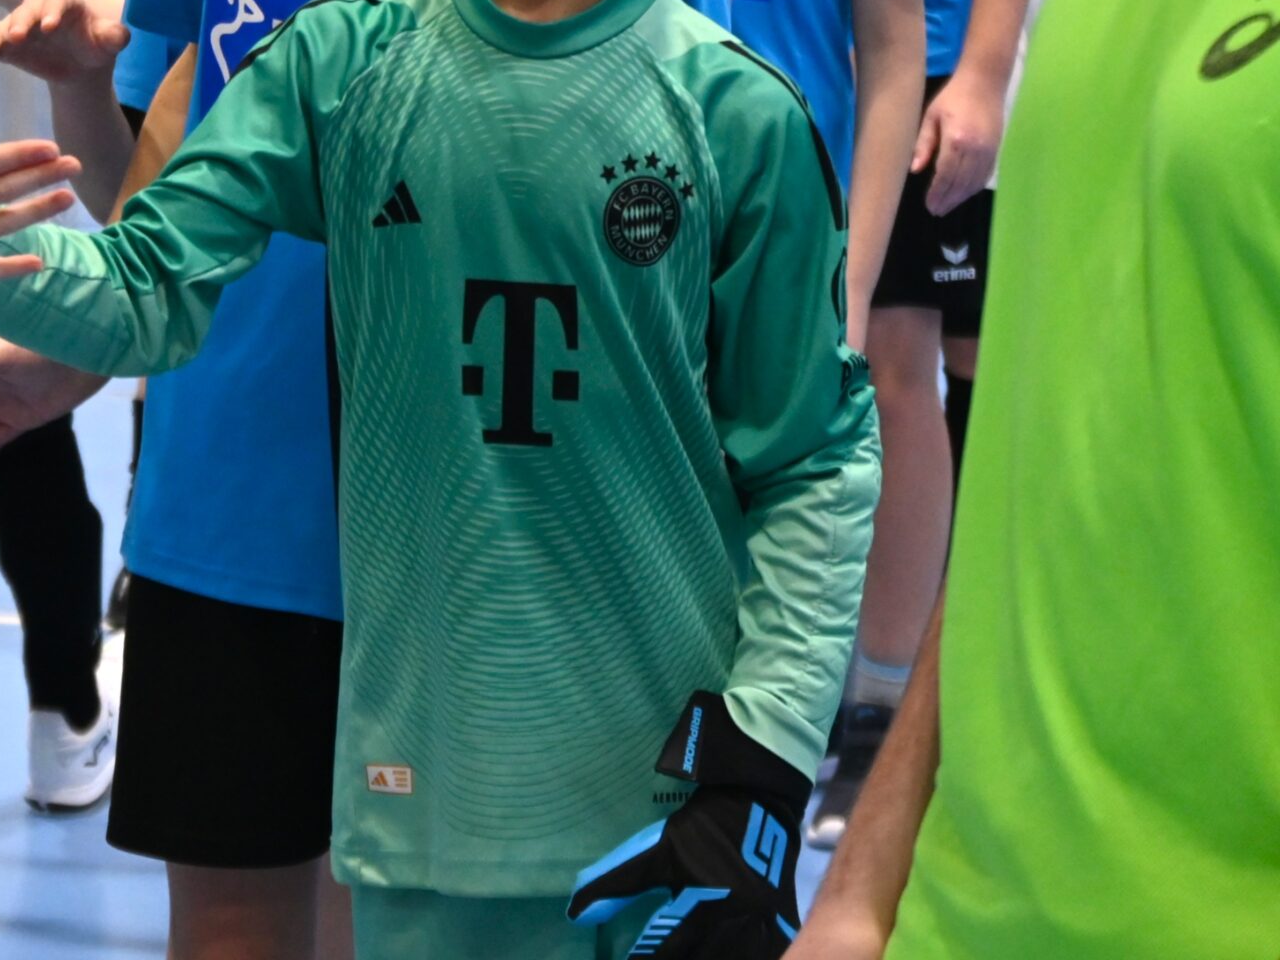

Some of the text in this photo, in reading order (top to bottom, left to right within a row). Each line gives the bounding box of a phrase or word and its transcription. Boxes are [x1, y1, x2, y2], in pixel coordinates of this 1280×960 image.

[613, 183, 674, 220] FC BAYERN
[933, 267, 976, 282] erima
[462, 278, 579, 447] T
